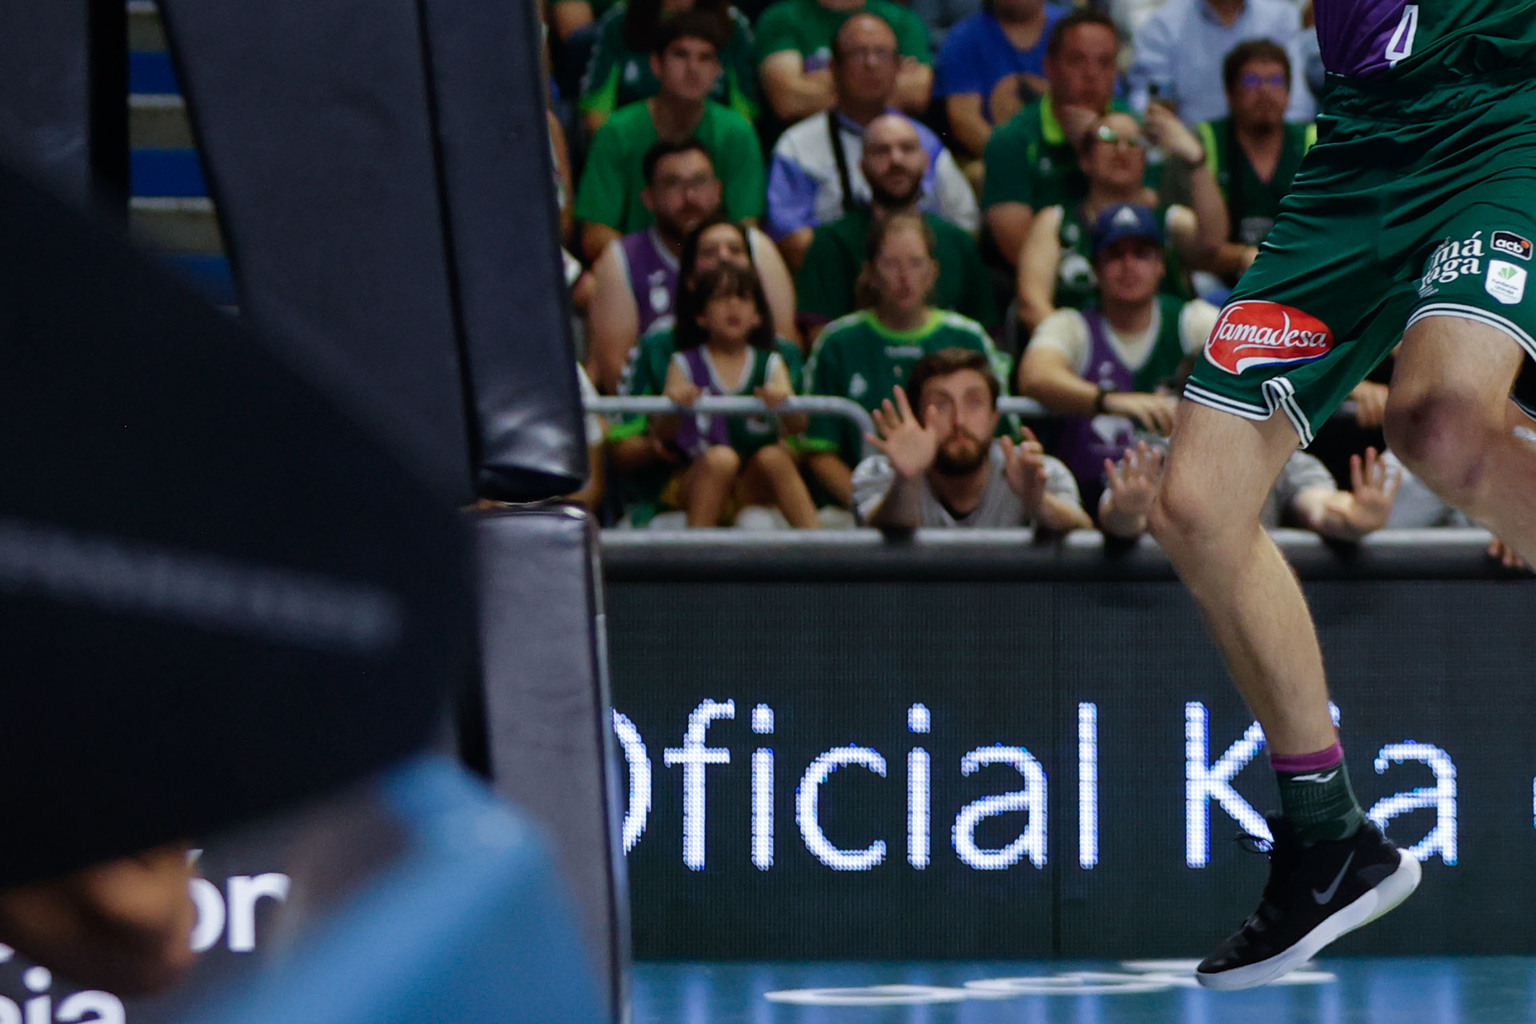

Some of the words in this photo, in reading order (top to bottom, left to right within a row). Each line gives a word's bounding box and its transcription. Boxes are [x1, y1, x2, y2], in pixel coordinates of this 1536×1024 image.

[1385, 4, 1419, 68] 4
[1495, 238, 1524, 253] acb
[1208, 306, 1327, 349] famadesa
[612, 698, 1100, 870] ficial
[1185, 700, 1459, 869] Ka
